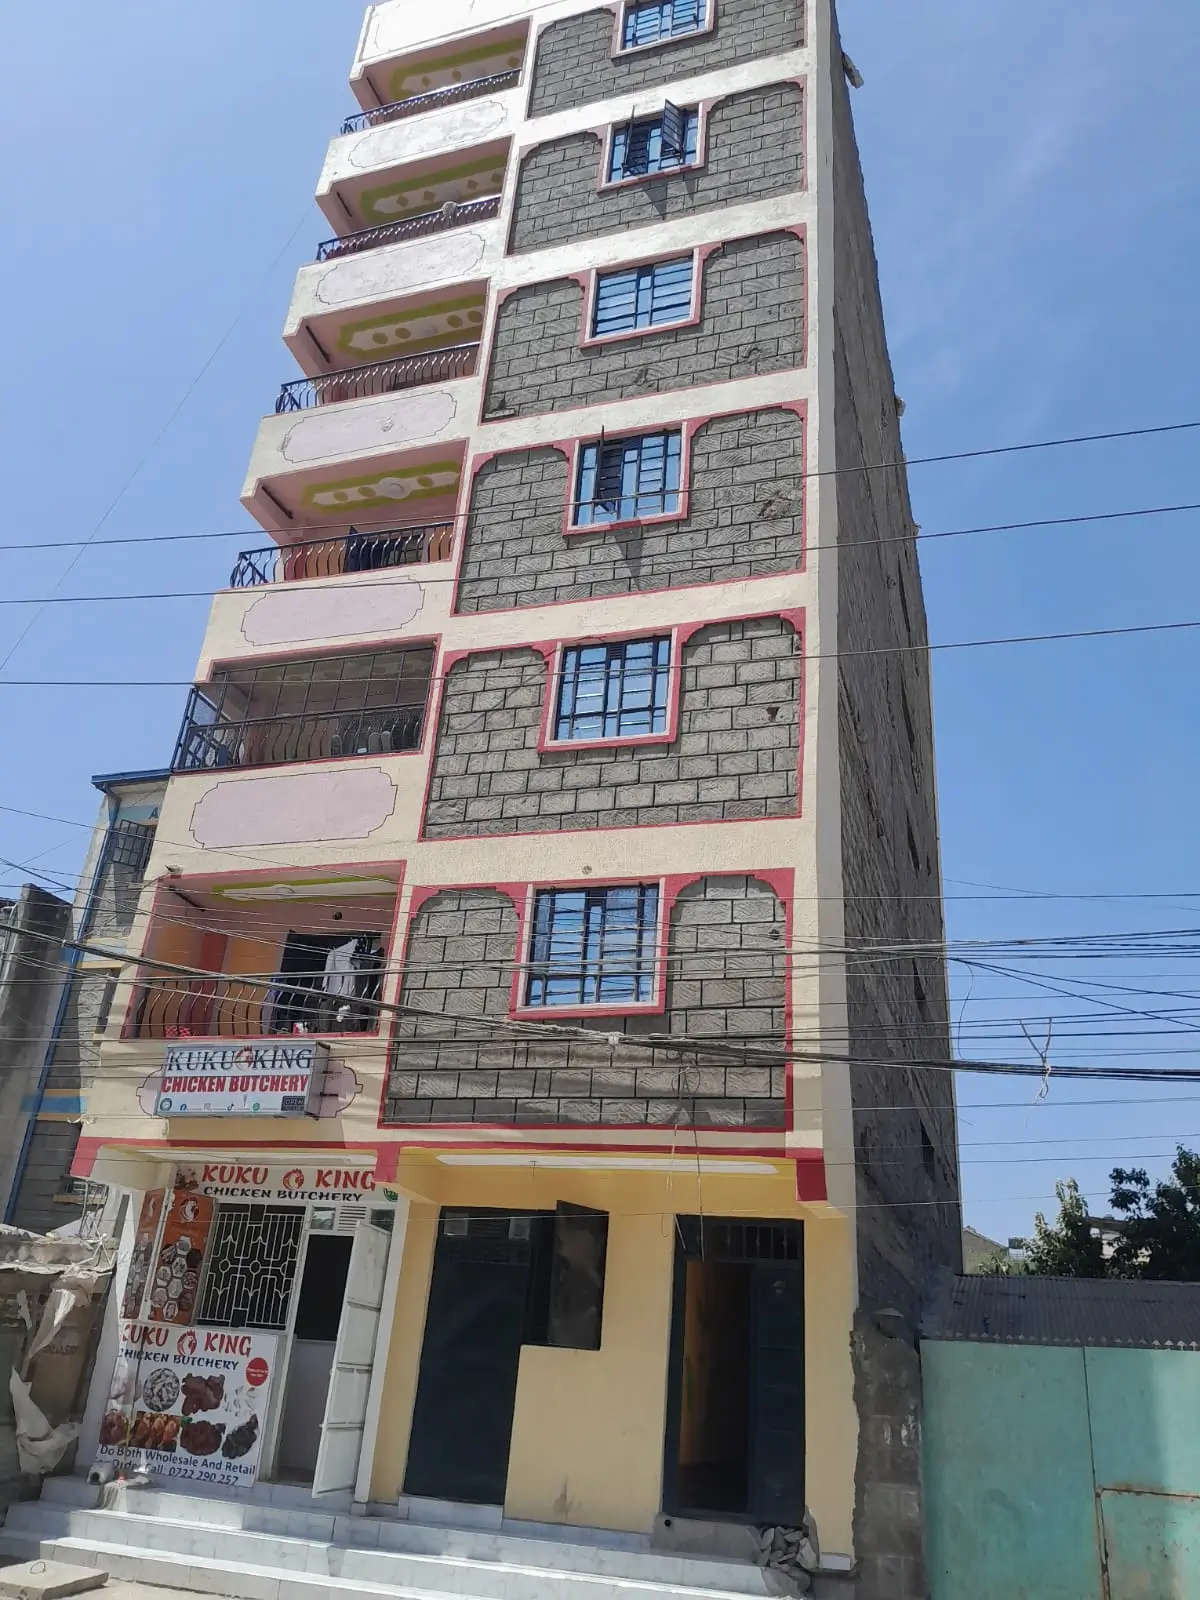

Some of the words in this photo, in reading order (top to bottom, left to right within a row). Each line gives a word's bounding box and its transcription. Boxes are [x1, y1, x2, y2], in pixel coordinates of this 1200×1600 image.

[167, 1050, 234, 1071] KUKU
[252, 1049, 312, 1069] KING
[161, 1077, 226, 1093] CHICKEN
[229, 1075, 308, 1092] BUTCHERY
[202, 1164, 269, 1185] KUKU
[315, 1169, 376, 1192] KING
[203, 1186, 272, 1199] CHICKEN
[276, 1190, 363, 1203] BUTCHERY
[204, 1332, 252, 1357] KING
[120, 1348, 170, 1363] HICKEN
[173, 1354, 239, 1371] BUTCHERY
[100, 1444, 115, 1456] Do
[116, 1447, 142, 1459] Both
[145, 1449, 199, 1467] Wholesale
[201, 1458, 223, 1471] And
[225, 1461, 256, 1475] Retail
[112, 1459, 143, 1471] Orde
[168, 1466, 195, 1480] 0722
[196, 1470, 217, 1483] 290
[218, 1474, 239, 1486] 257
